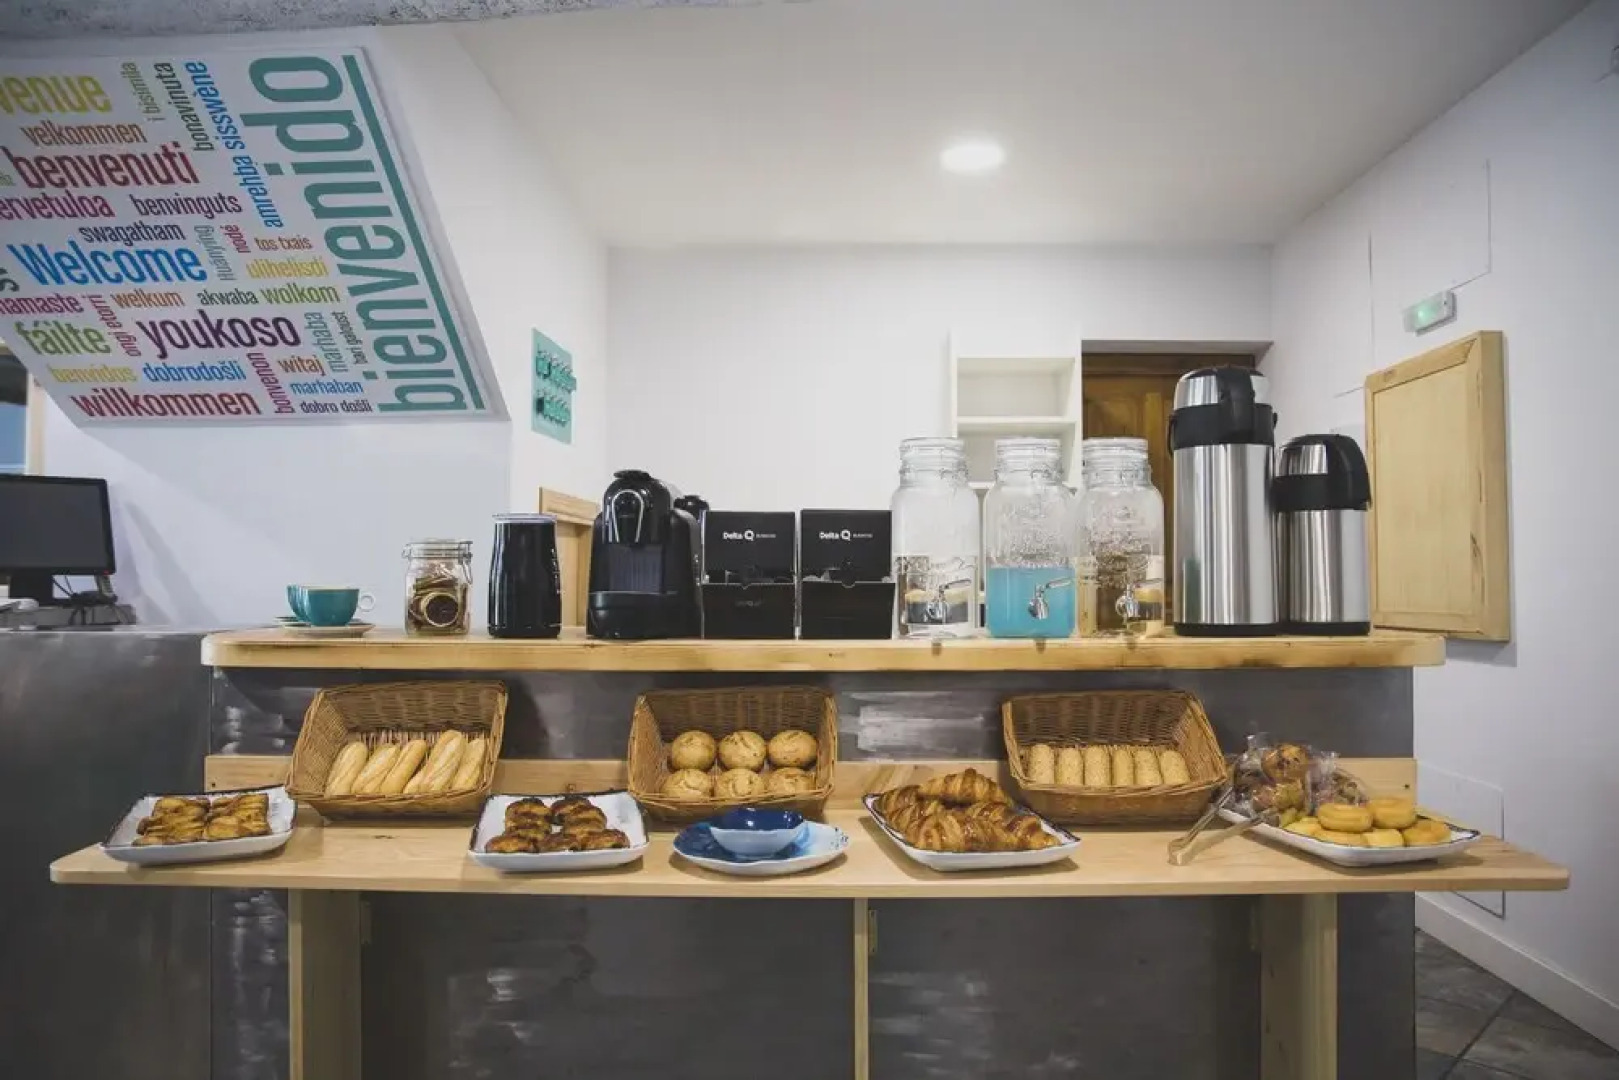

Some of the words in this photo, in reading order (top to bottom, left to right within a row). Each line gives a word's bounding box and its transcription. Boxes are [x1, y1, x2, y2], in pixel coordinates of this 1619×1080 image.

[153, 62, 215, 150] bonavinuta
[185, 62, 246, 149] sisswene
[20, 118, 148, 146] velkommen
[1, 141, 199, 188] benvenuti
[232, 155, 284, 227] amrehba
[129, 192, 242, 219] benvinguts
[79, 220, 186, 246] swagatham
[240, 56, 467, 412] bienvenido
[254, 237, 279, 251] tos
[6, 239, 208, 285] Welcome
[0, 292, 84, 314] namaste
[110, 288, 185, 309] welkum
[197, 288, 259, 306] akwaba
[260, 282, 340, 305] wolkom
[81, 294, 122, 328] etorri
[107, 331, 142, 356] ongi
[136, 309, 301, 359] youkoso
[304, 312, 348, 372] marhaba
[278, 354, 326, 377] witaj
[247, 353, 296, 414] bonvenon
[290, 379, 364, 396] marhaban
[70, 387, 262, 417] willkommen
[300, 400, 339, 414] dobro
